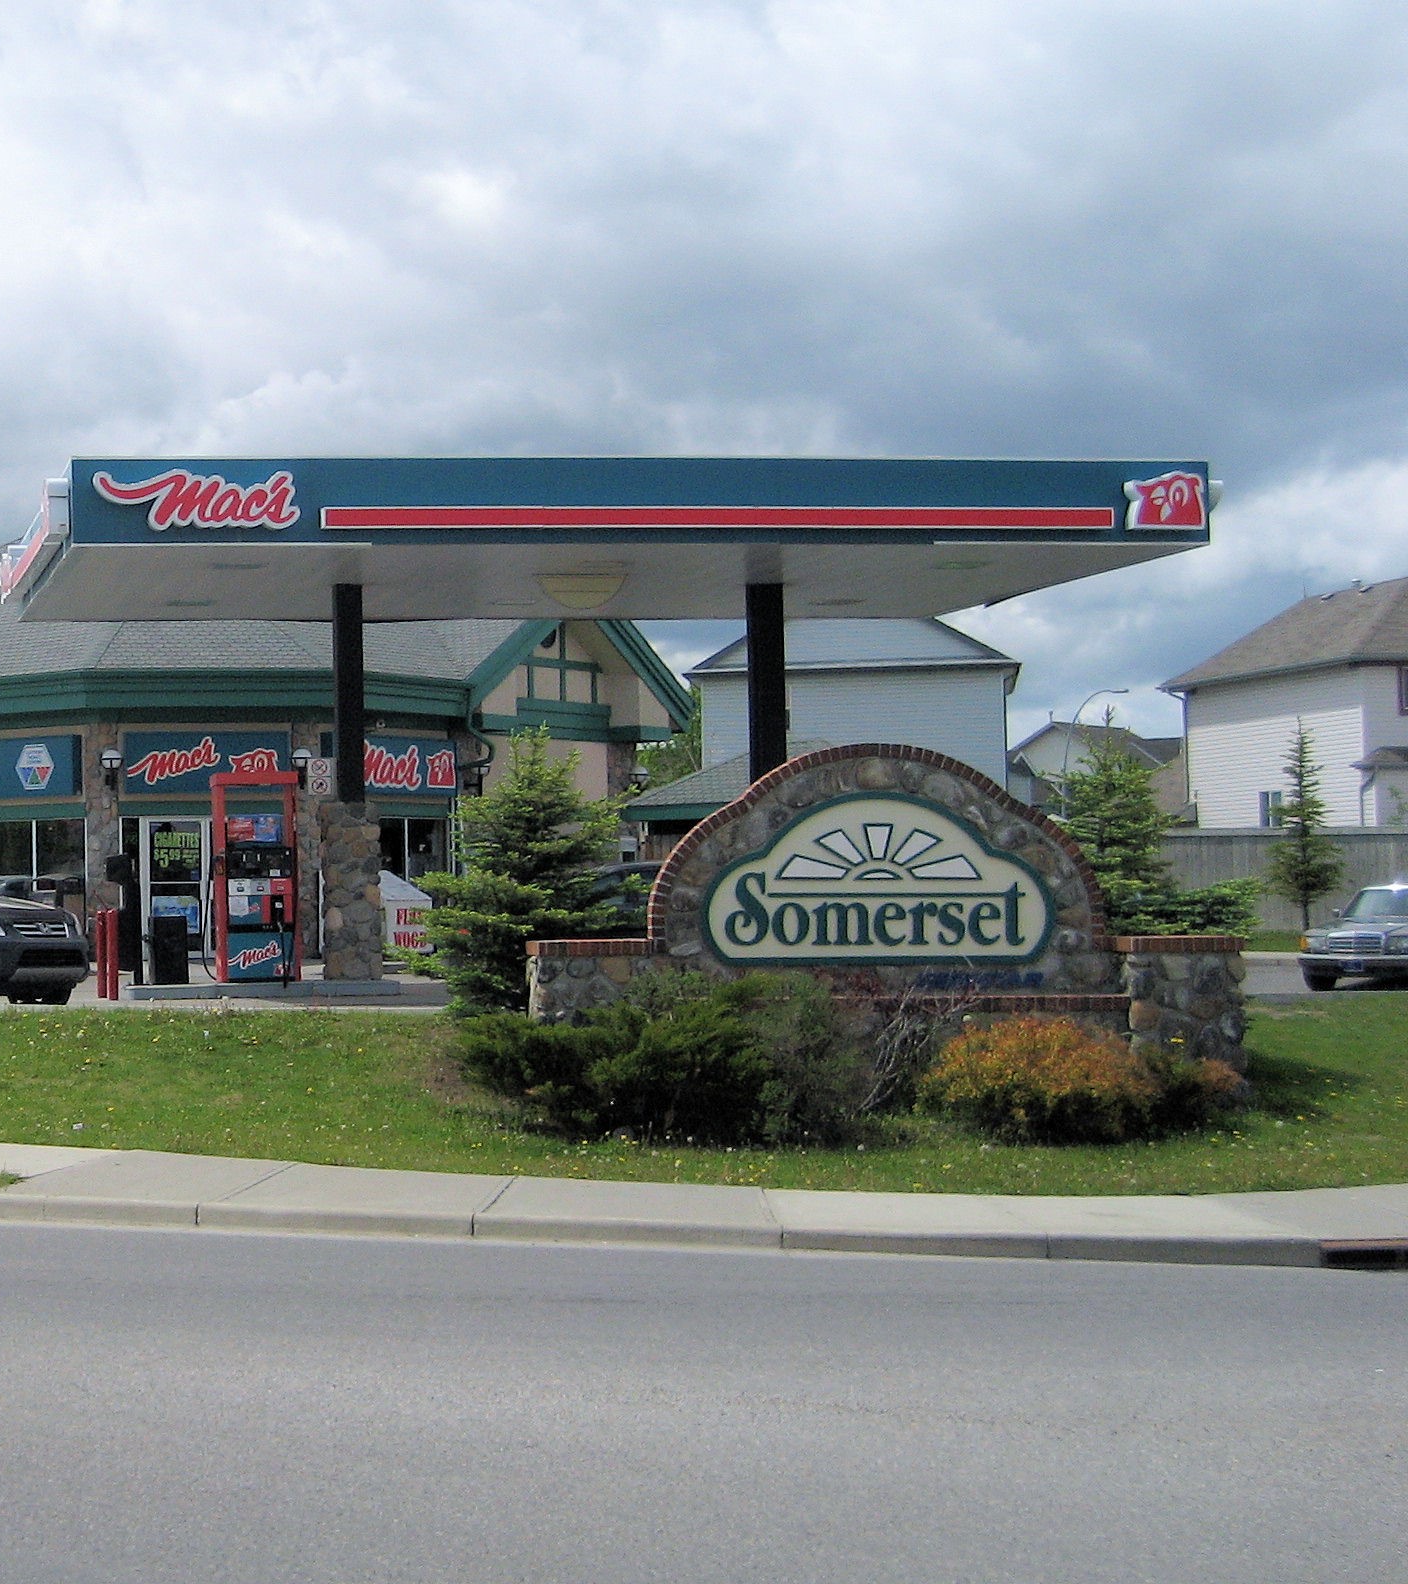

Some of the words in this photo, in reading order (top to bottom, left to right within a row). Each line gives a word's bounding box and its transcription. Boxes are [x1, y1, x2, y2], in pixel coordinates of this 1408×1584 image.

[93, 469, 300, 531] Mac's
[127, 737, 221, 785] Mac's
[724, 871, 1027, 947] Somerset
[228, 940, 283, 970] Mac's
